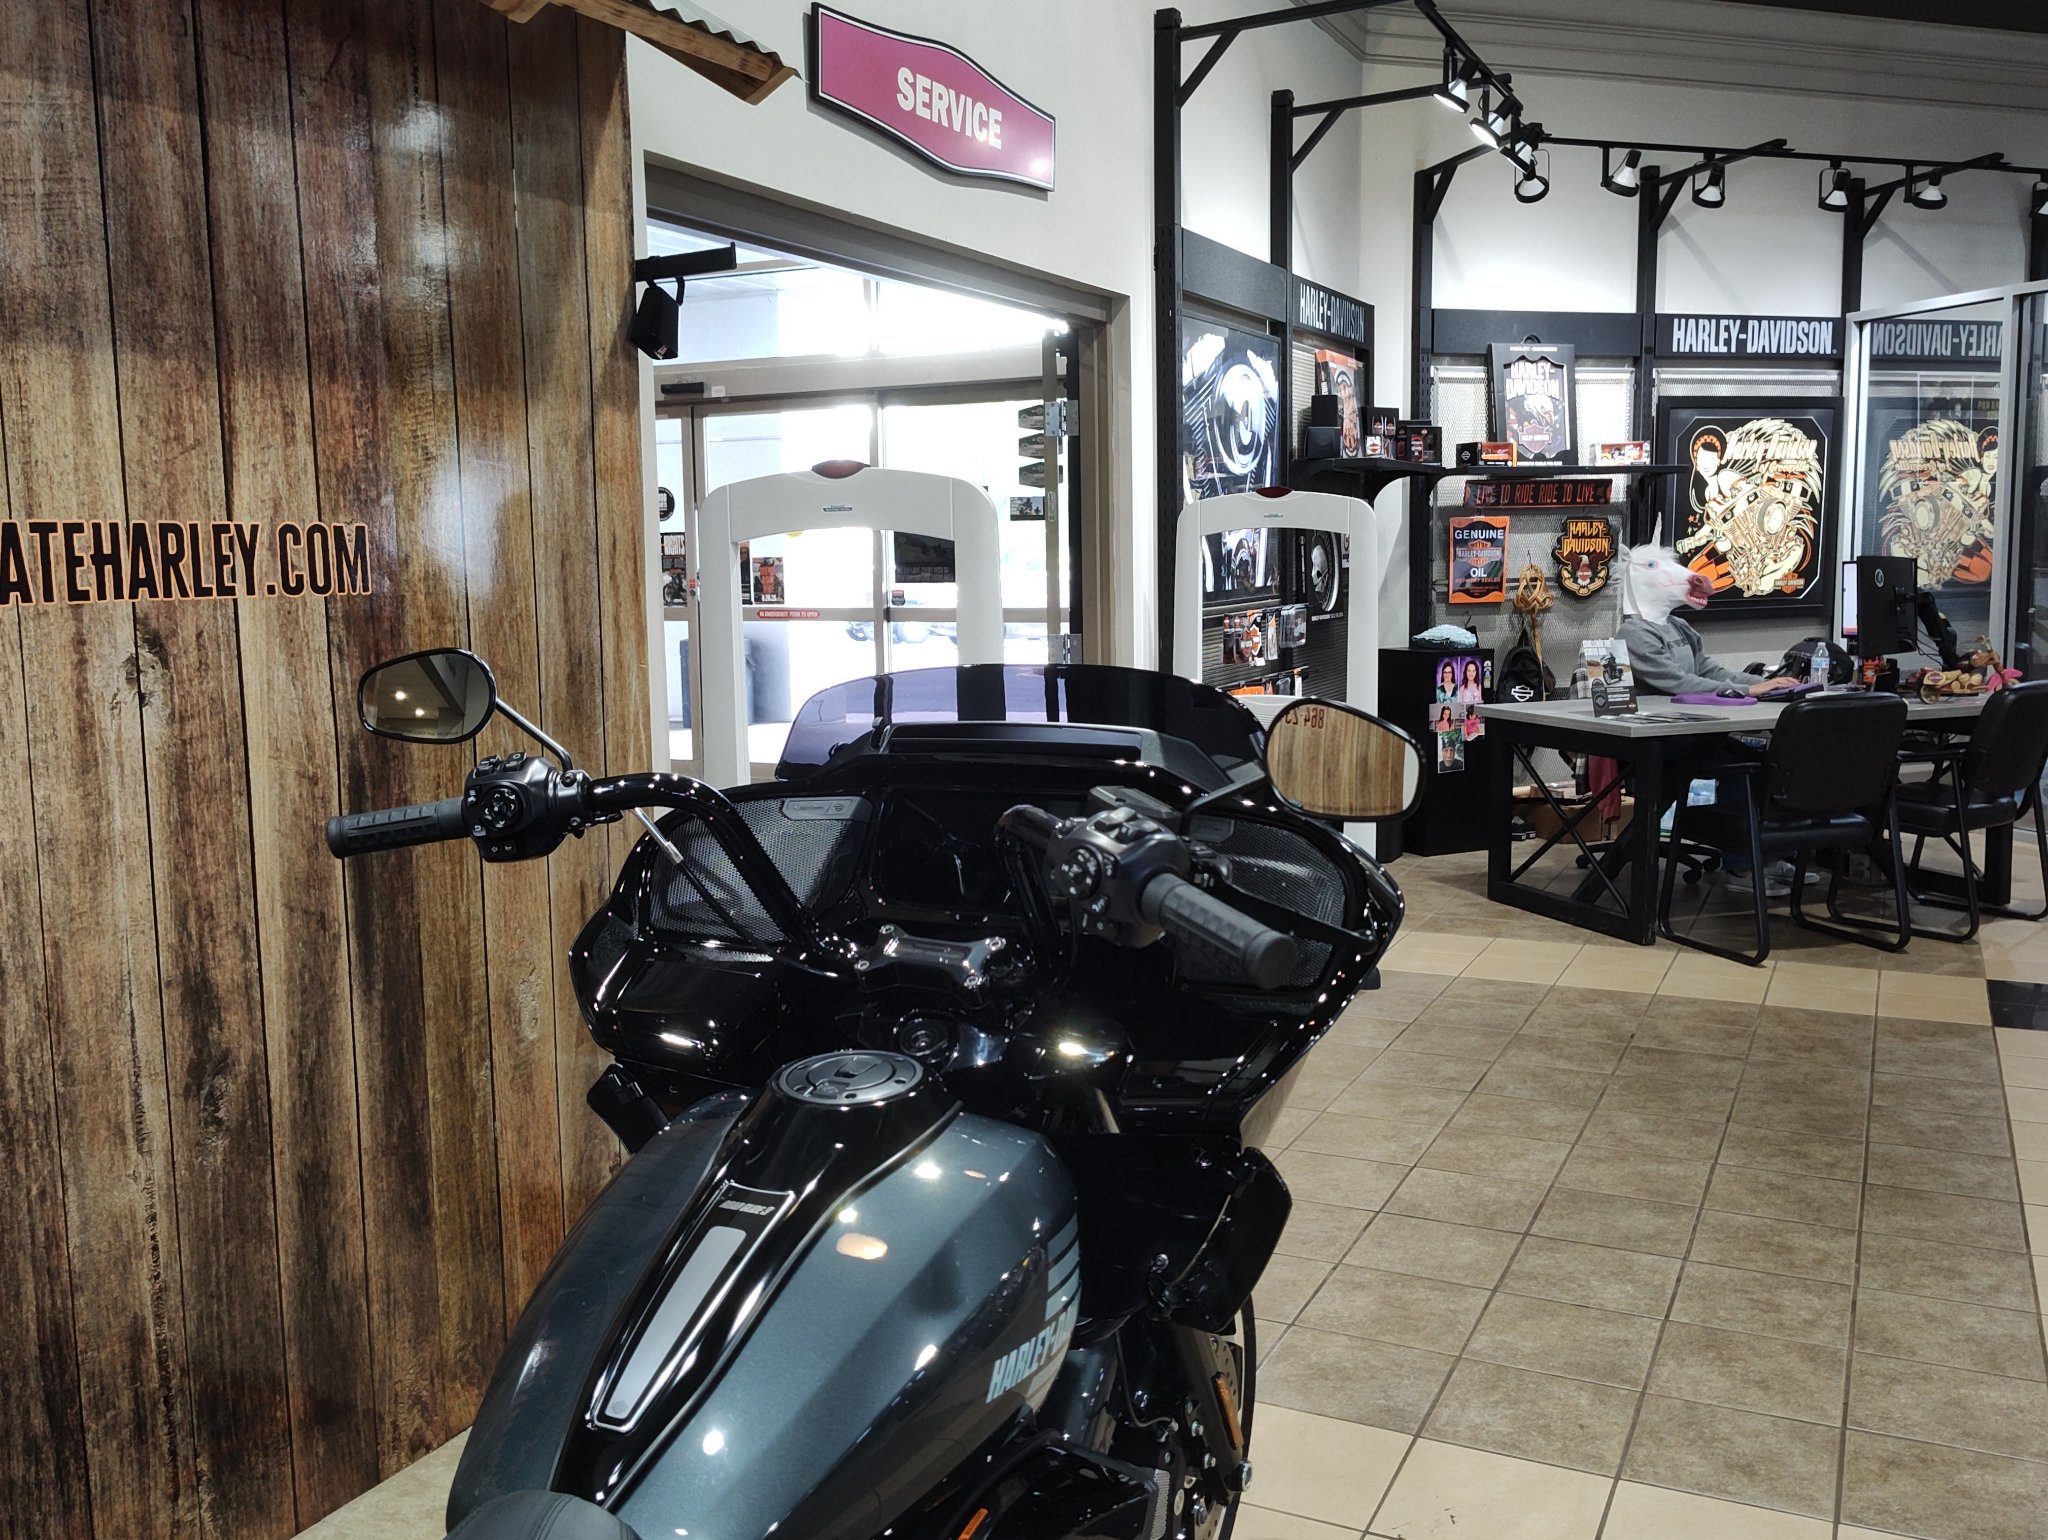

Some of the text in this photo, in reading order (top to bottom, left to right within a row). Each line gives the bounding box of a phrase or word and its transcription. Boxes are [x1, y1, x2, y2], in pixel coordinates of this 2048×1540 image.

[896, 66, 1003, 150] SERVICE
[1300, 283, 1365, 343] HARLEY-DAVIDSON
[1672, 317, 1834, 354] HARLEY-DAVIDSON
[1506, 378, 1560, 400] DAVIDSON
[1500, 484, 1511, 503] TO
[1515, 484, 1534, 503] RIDE
[1538, 484, 1558, 503] RIDE
[1562, 484, 1574, 503] TO
[1576, 483, 1595, 503] LIVE
[1454, 529, 1504, 539] GENUINE
[1563, 538, 1609, 557] DAVIDSON
[0, 519, 371, 606] ATEHARLEY.COM
[1470, 567, 1487, 578] OIL
